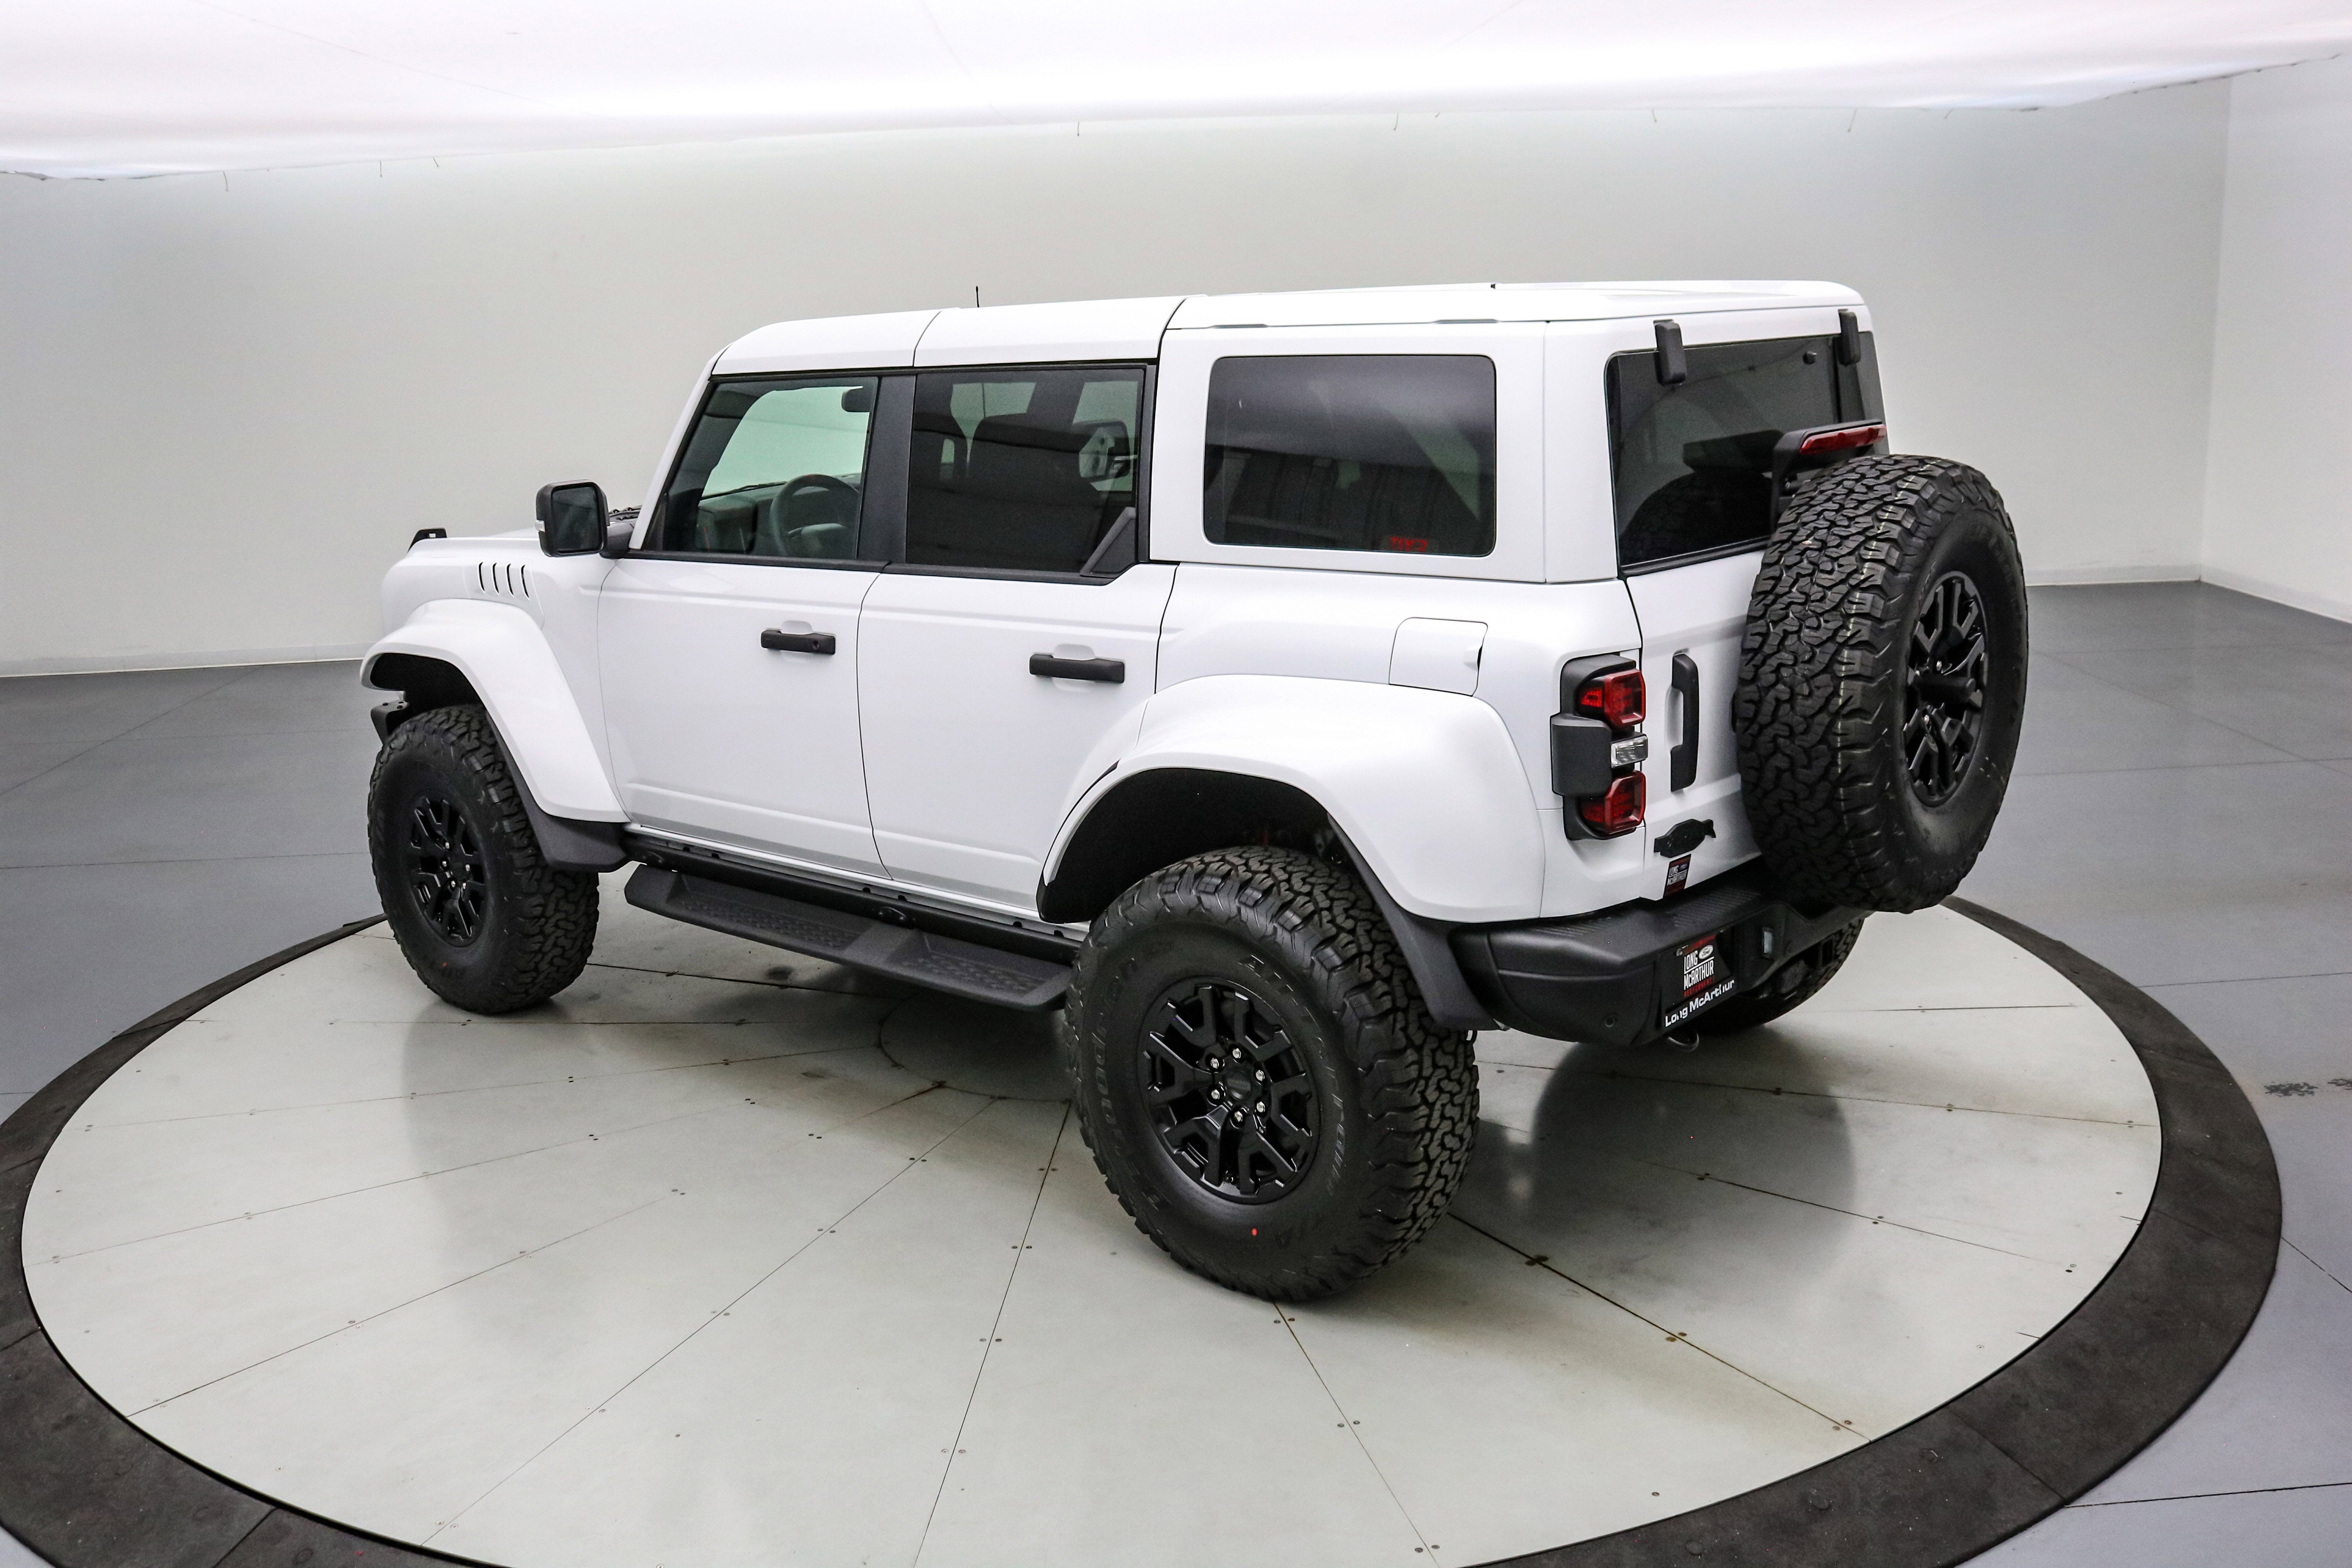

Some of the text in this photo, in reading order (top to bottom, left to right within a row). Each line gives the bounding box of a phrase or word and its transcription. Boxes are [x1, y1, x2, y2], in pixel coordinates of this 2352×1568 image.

[1684, 950, 1698, 974] LONG
[1665, 1007, 1688, 1027] Long
[1689, 979, 1735, 1013] McArthur
